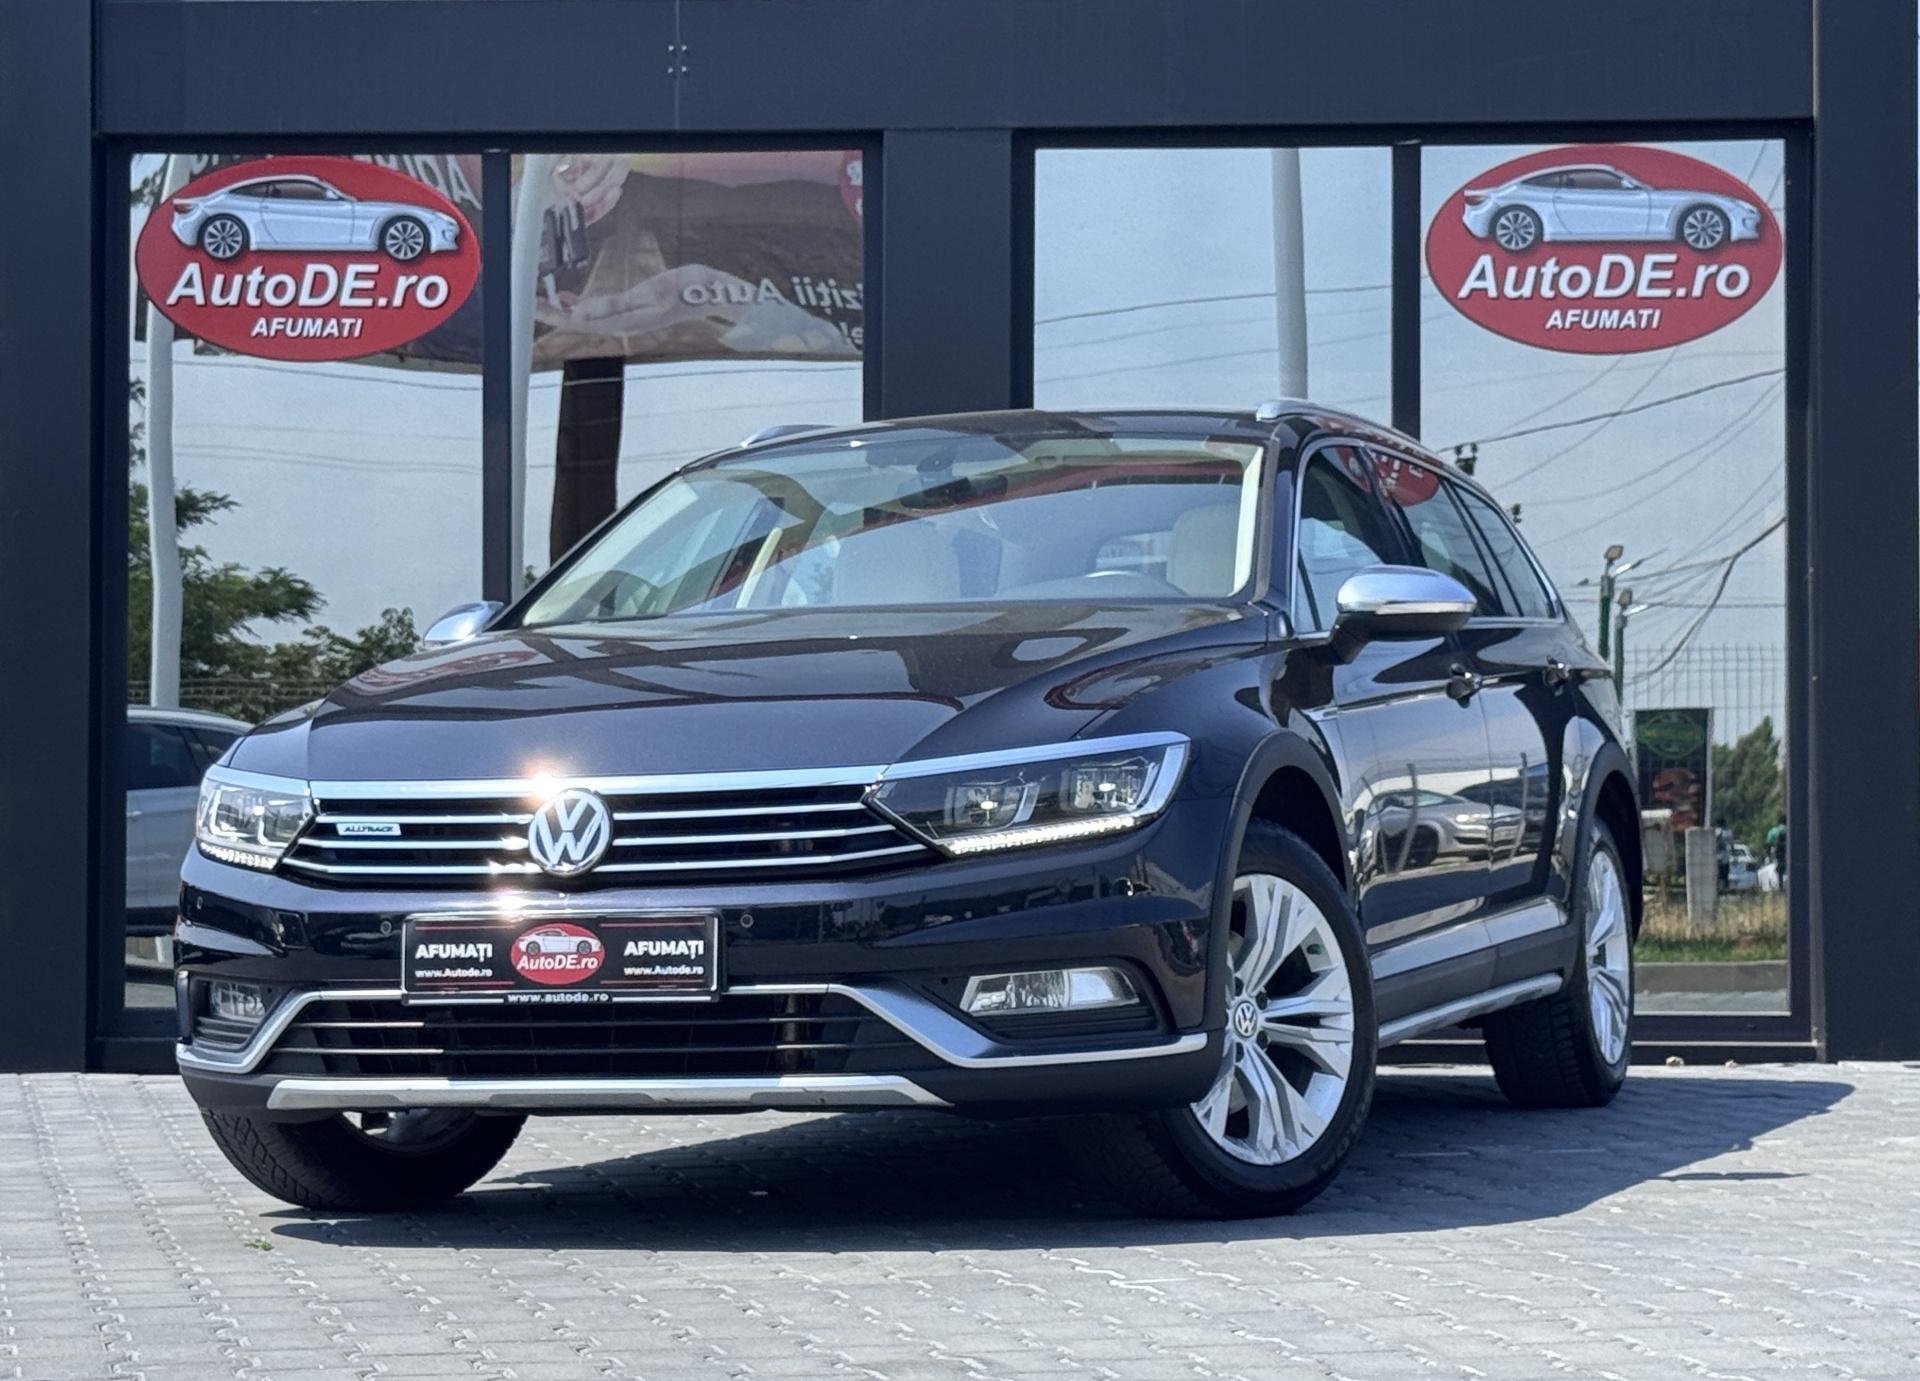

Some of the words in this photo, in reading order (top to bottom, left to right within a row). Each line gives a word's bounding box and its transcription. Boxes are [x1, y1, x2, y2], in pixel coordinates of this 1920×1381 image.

[166, 262, 449, 309] AutoDE.ro
[1457, 252, 1750, 300] AutoDE.ro
[250, 317, 363, 338] AFUMATI
[1546, 309, 1661, 330] AFUMATI
[516, 954, 599, 971] AutoDE.ro
[507, 992, 609, 1003] www.autode.ro
